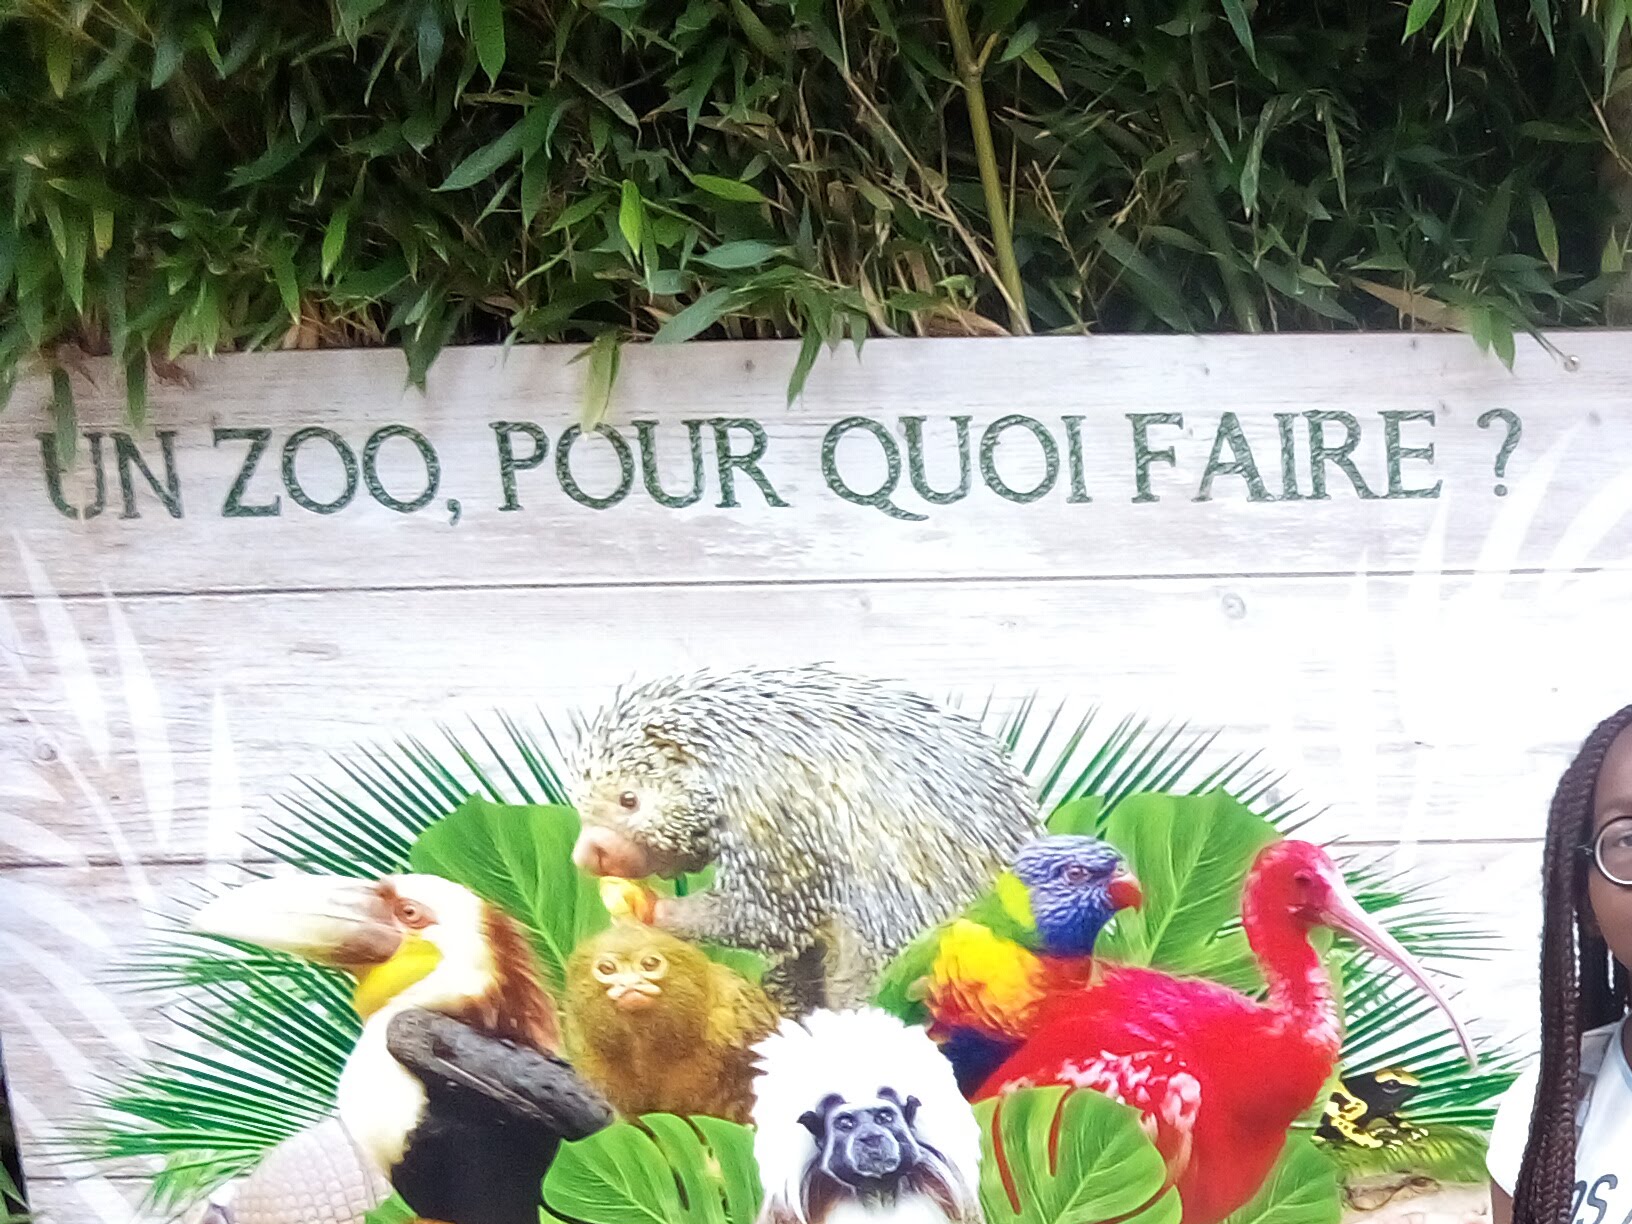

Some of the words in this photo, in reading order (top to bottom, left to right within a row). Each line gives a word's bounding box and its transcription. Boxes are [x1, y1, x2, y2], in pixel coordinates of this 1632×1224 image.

[35, 429, 183, 520] UN
[212, 423, 462, 526] ZOO,
[488, 416, 792, 511] POUR
[820, 413, 1093, 521] QUOI
[1125, 408, 1443, 504] FAIRE
[1476, 407, 1523, 498] ?
